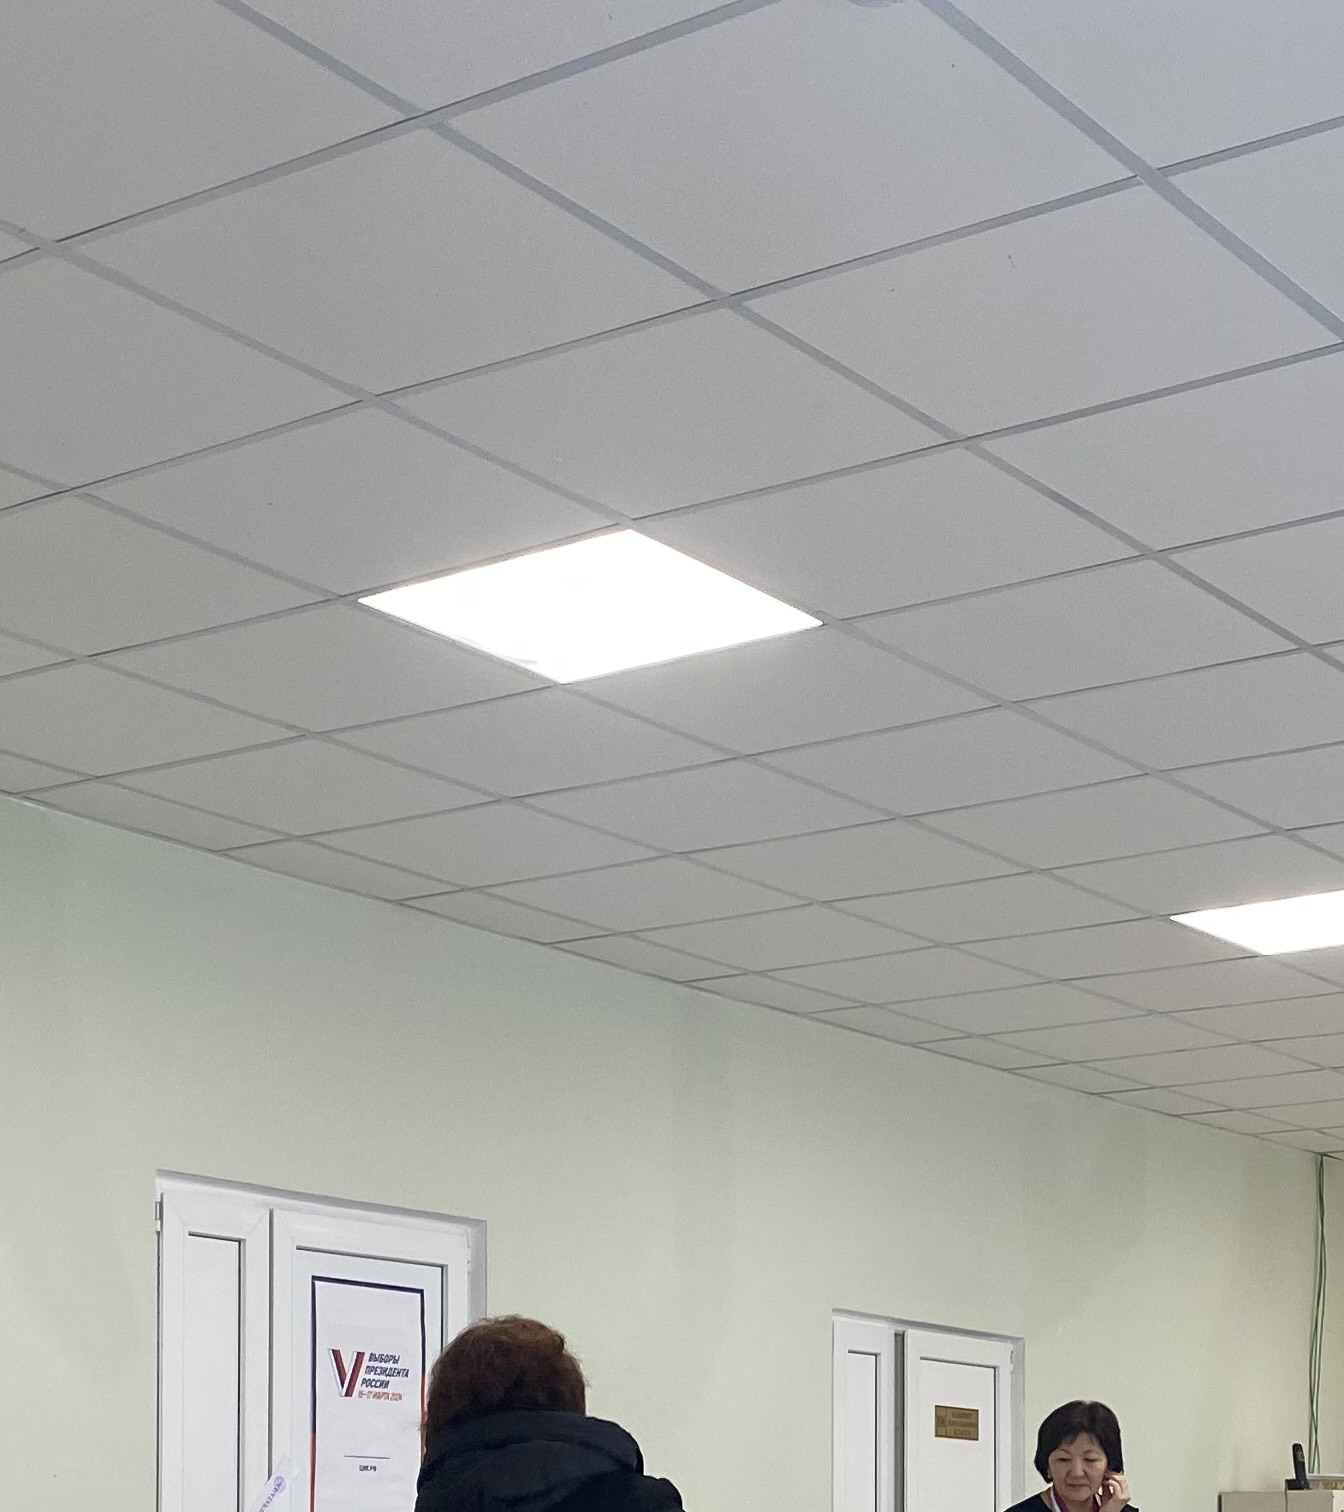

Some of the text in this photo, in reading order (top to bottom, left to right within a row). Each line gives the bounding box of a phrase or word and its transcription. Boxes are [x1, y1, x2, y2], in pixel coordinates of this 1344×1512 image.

[368, 1352, 400, 1364] ВЫБОРЫ
[364, 1365, 409, 1379] ПРЕЗИДЕНТА
[360, 1378, 390, 1389] РОССИИ
